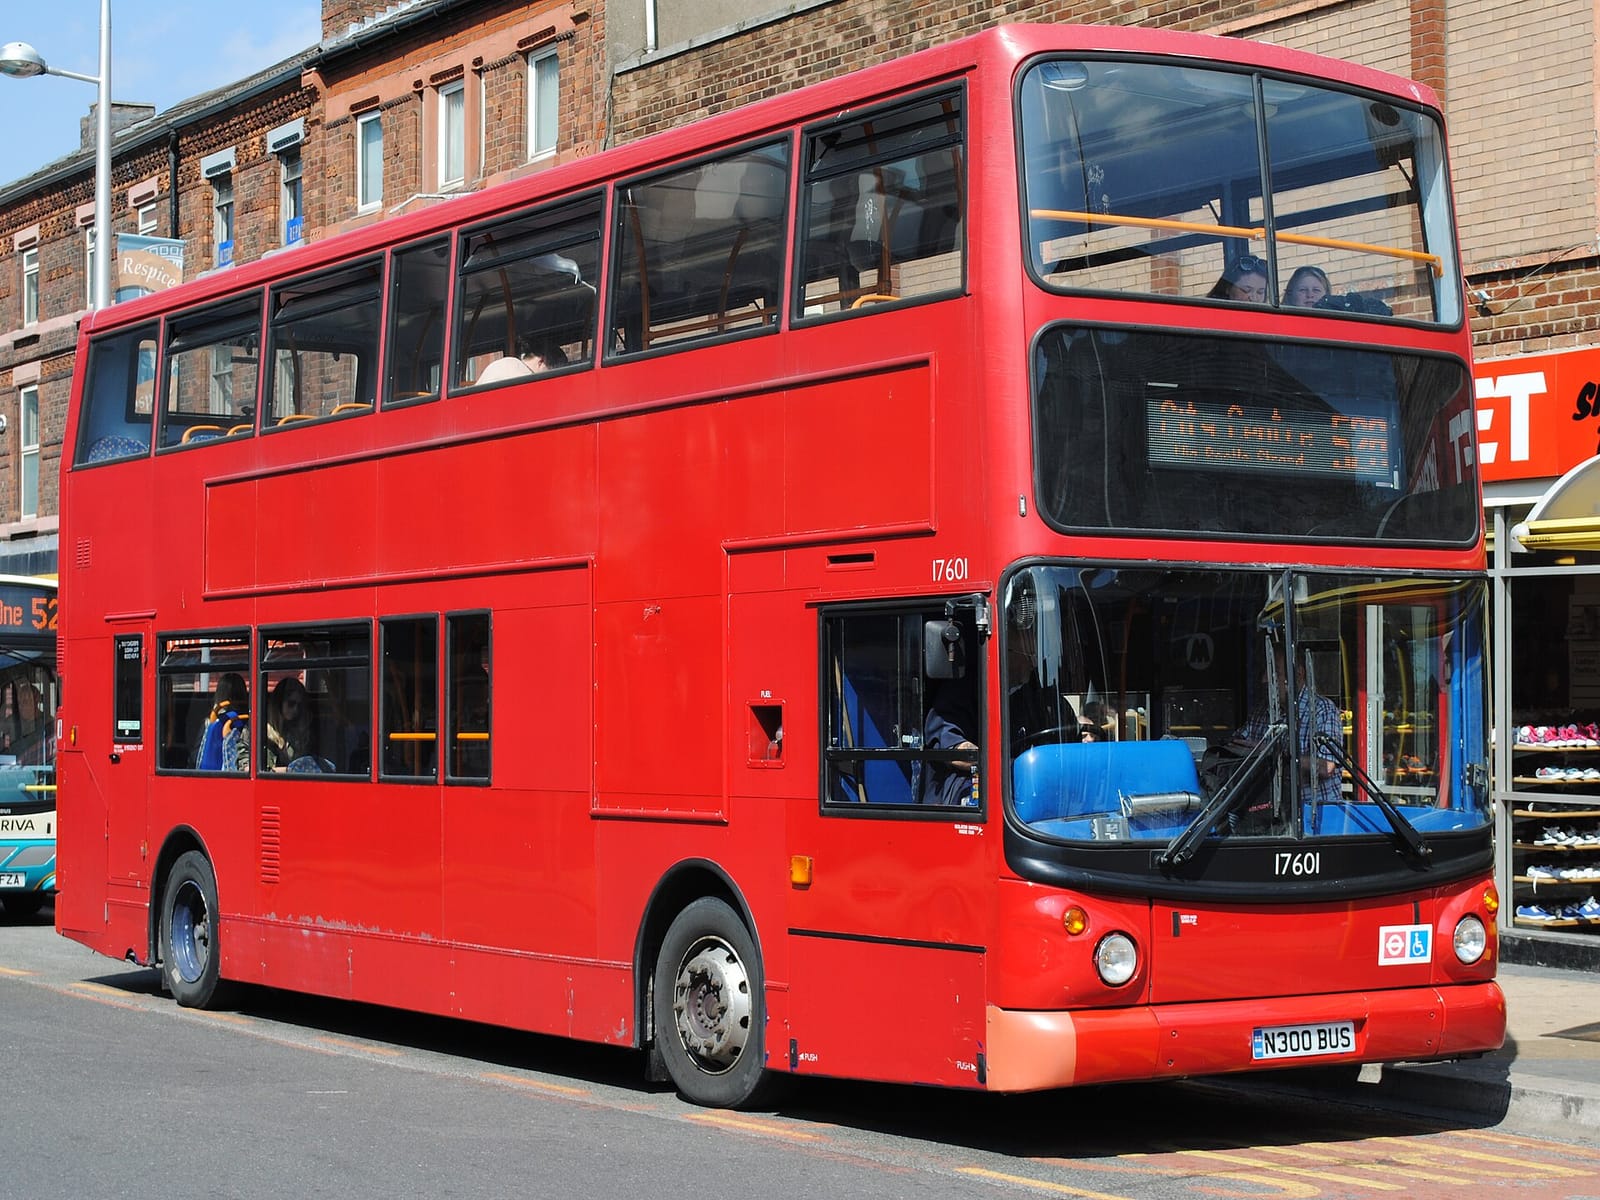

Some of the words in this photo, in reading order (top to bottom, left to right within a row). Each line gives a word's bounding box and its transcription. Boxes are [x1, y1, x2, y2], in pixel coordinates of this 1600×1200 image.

[123, 257, 176, 288] Respice
[932, 557, 968, 582] 17601
[1274, 852, 1320, 876] 17601
[1264, 1030, 1312, 1055] N300
[1316, 1026, 1351, 1050] BUS
[804, 1053, 818, 1062] PUSH
[956, 1060, 971, 1071] PUSH
